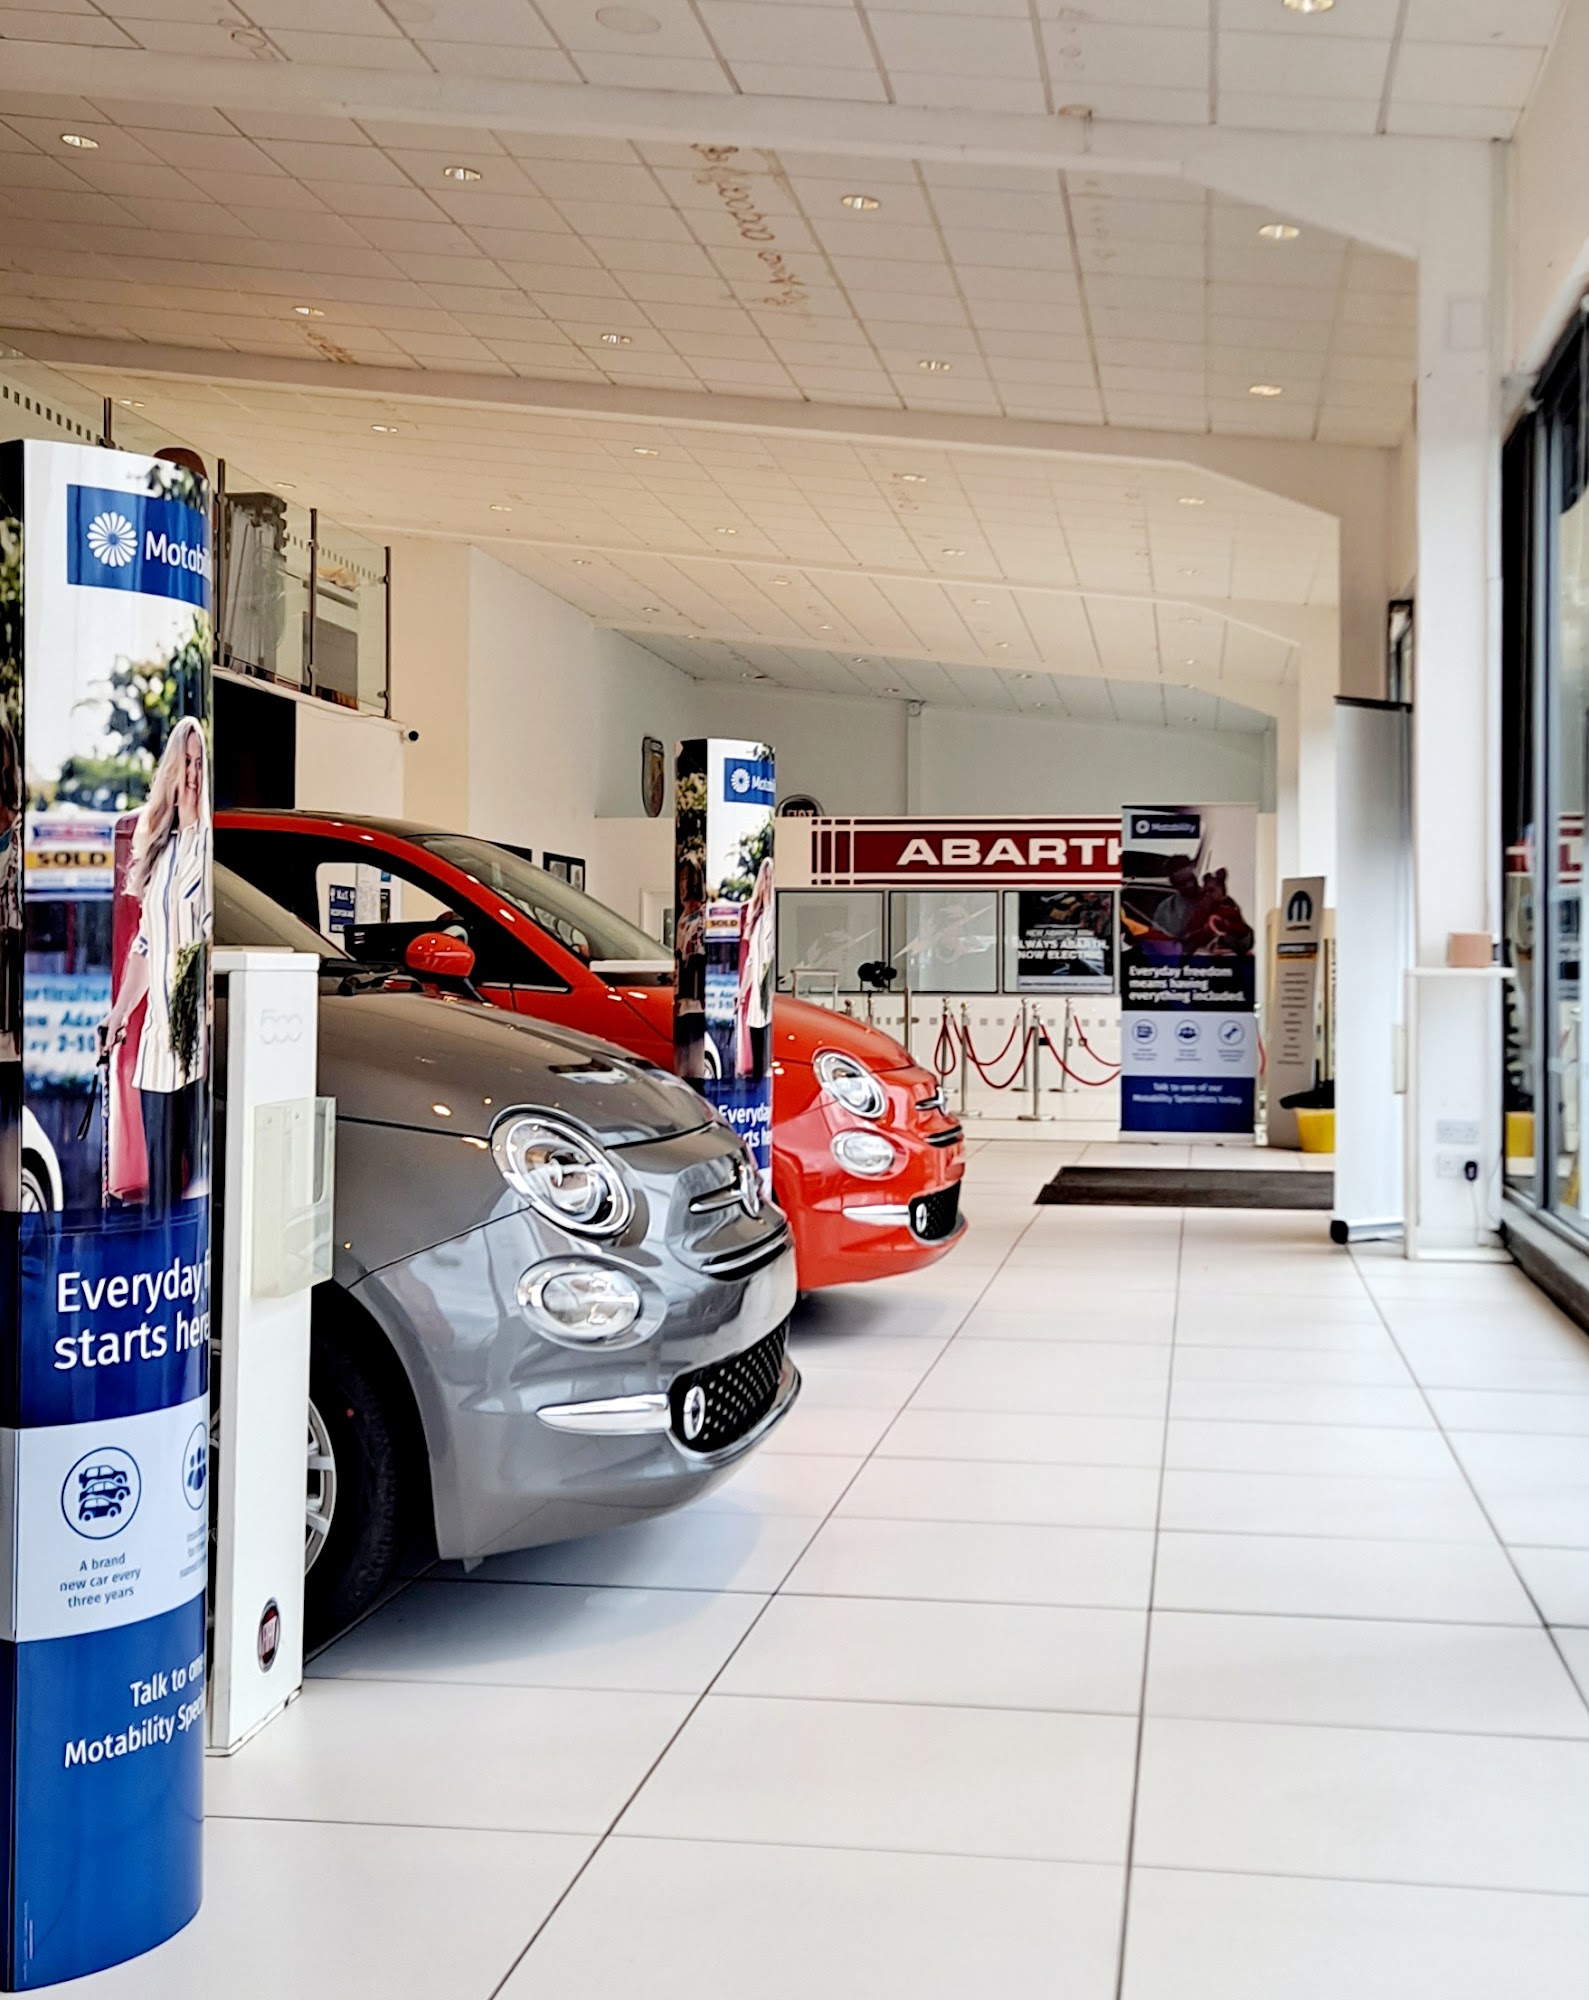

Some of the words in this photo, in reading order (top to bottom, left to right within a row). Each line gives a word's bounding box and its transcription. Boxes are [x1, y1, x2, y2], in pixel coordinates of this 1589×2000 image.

[38, 850, 106, 868] SOLD
[710, 918, 738, 928] SOLD
[1017, 950, 1046, 960] NOW
[1128, 965, 1180, 979] Everyday
[1183, 964, 1233, 977] freedom
[1128, 979, 1168, 989] means
[1169, 977, 1209, 992] having
[1128, 989, 1191, 1004] everything
[58, 1256, 203, 1315] Everyday
[53, 1321, 168, 1370] starts
[79, 1560, 88, 1572] A
[92, 1552, 126, 1570] brand
[60, 1580, 86, 1592] new
[90, 1577, 108, 1588] car
[112, 1568, 142, 1583] every
[68, 1594, 100, 1608] three
[104, 1586, 135, 1604] years
[130, 1671, 168, 1708] Talk
[171, 1667, 187, 1692] to
[64, 1714, 176, 1769] Motability
